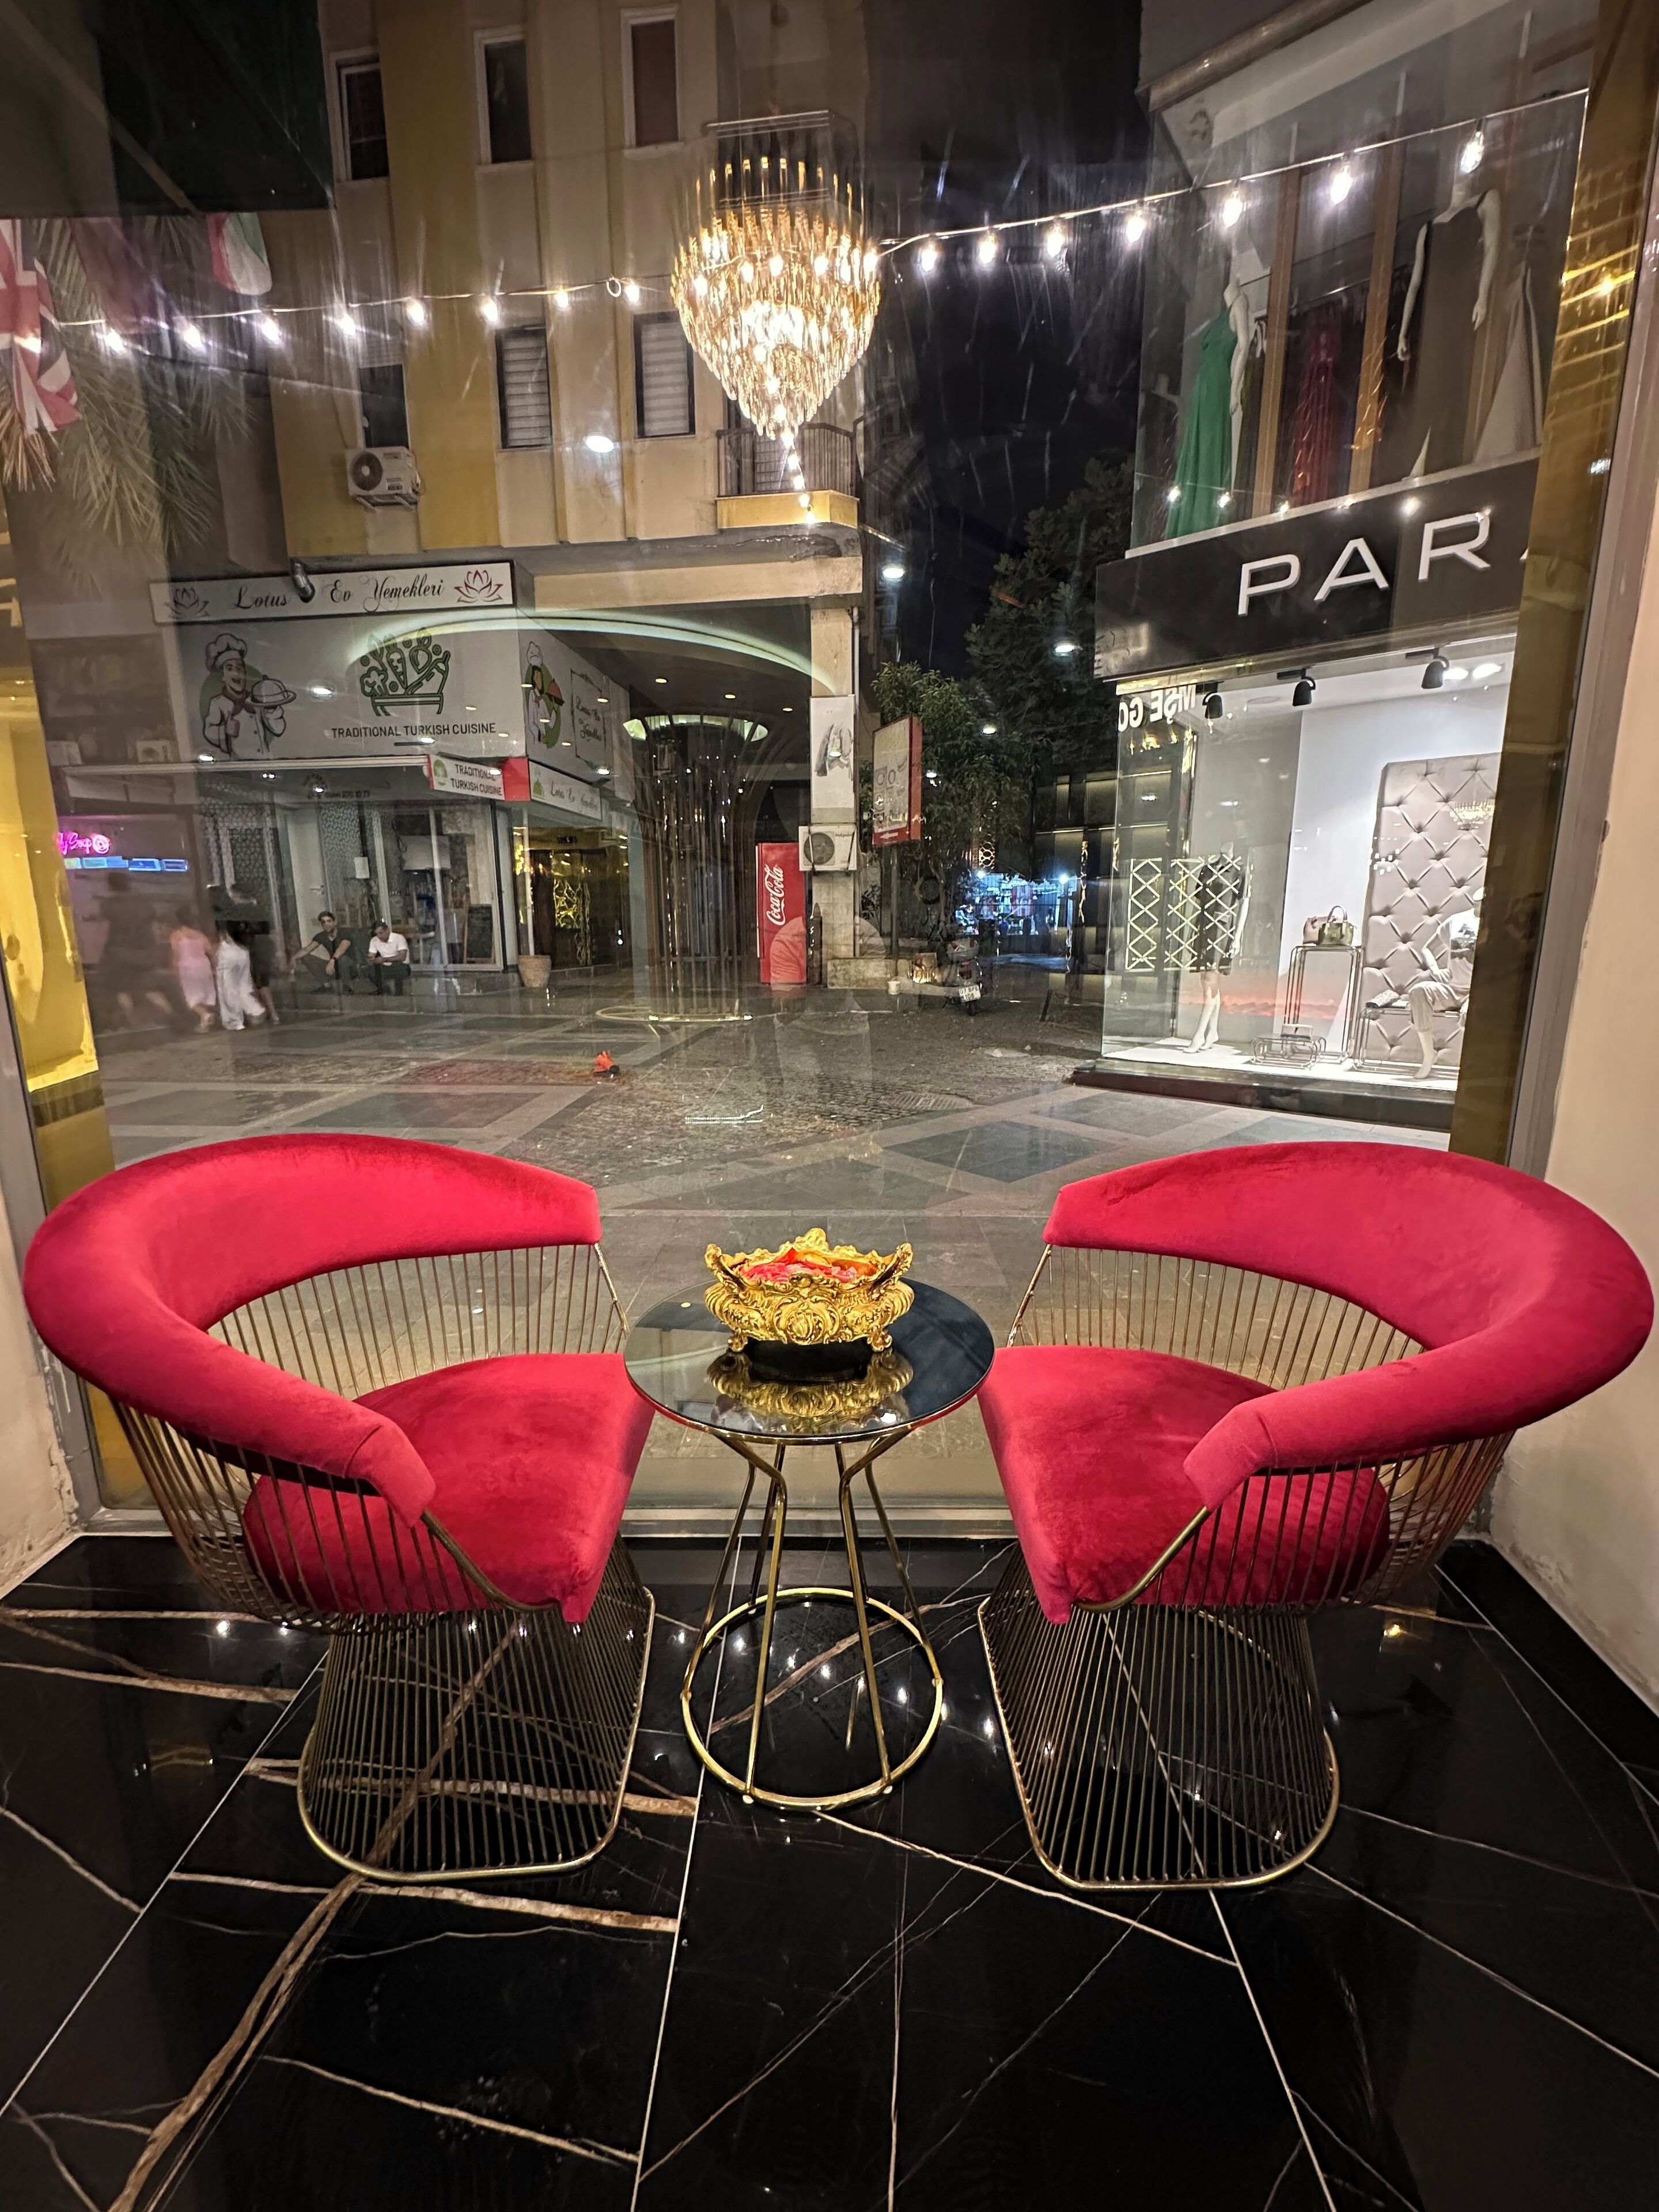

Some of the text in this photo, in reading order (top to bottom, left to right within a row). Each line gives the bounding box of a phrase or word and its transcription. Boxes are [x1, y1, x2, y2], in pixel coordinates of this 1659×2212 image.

[1238, 512, 1529, 616] PAR
[232, 573, 445, 612] Lotus Ev Yemekleri
[331, 722, 496, 738] TRADITIONAL TURKISH CUISINE
[450, 778, 502, 796] TURKISH CUISINE
[764, 863, 786, 926] Coca-Cola
